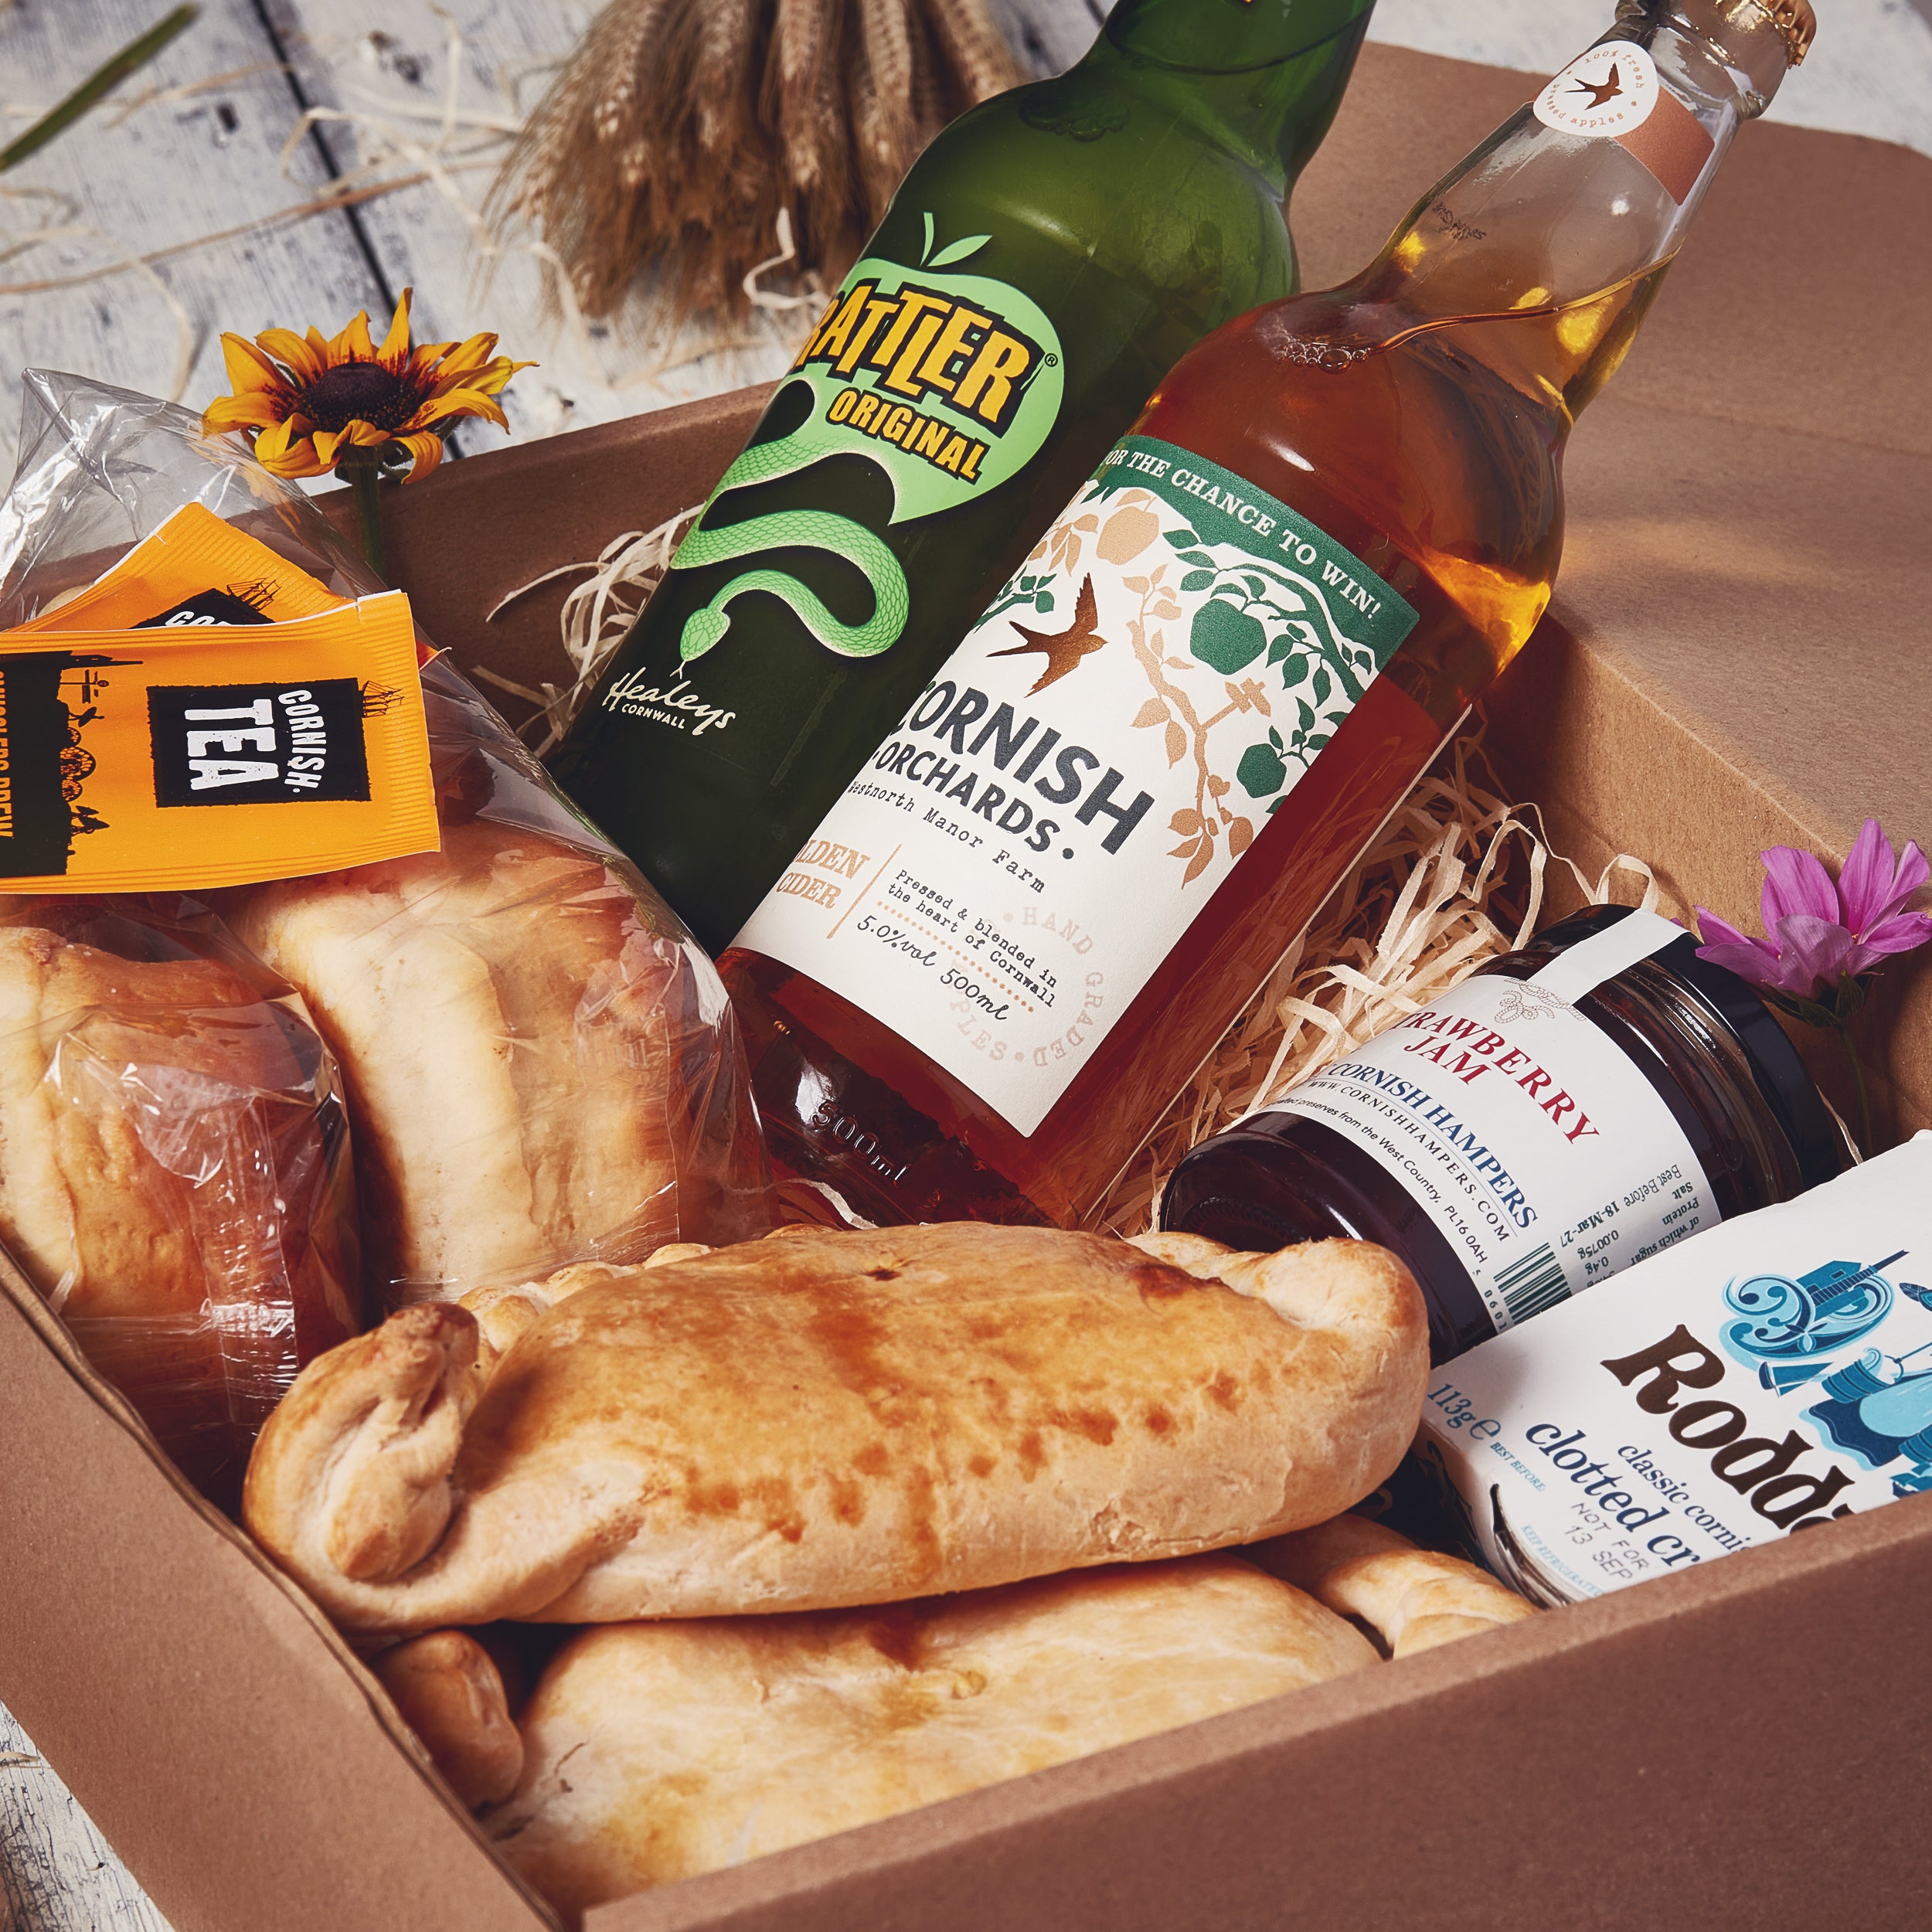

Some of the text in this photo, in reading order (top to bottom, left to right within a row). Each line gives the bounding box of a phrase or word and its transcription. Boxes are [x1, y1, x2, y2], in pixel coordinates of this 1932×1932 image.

[1584, 50, 1645, 89] 100% fresh
[1570, 113, 1624, 128] apples
[827, 389, 988, 483] ORIGINAL
[1127, 451, 1171, 478] THE
[1171, 469, 1277, 537] CHANCE
[1278, 529, 1316, 566] TO
[1321, 560, 1382, 619] WIN!
[185, 699, 278, 791] TEA
[621, 704, 685, 729] CORNWALL
[923, 808, 983, 848] Manor
[992, 849, 1045, 893] Farm
[776, 872, 841, 909] CIDER
[896, 870, 953, 910] Pressed
[957, 909, 968, 920] &
[975, 917, 1035, 969] blended
[1039, 969, 1057, 988] in
[889, 883, 910, 903] the
[917, 900, 958, 933] heart
[965, 934, 985, 950] of
[990, 951, 1056, 1008] Cornwall
[940, 968, 1009, 1020] 500ml
[1022, 906, 1104, 1067] HAND GRADED
[1403, 1036, 1492, 1086] JAM
[1298, 1098, 1341, 1116] preserves
[1338, 1111, 1362, 1128] from
[1361, 1126, 1378, 1140] the
[1379, 1137, 1404, 1162] West
[1403, 1159, 1440, 1202] Country,
[1328, 1063, 1538, 1229] CORNISH HAMPERS
[1560, 1165, 1682, 1247] Best Before 18-Mar-27
[1672, 1182, 1693, 1199] Salt
[1689, 1216, 1699, 1230] of
[1585, 1197, 1699, 1275] Protein 0.4g
[1658, 1225, 1689, 1247] which
[1490, 1442, 1515, 1461] BEST
[1526, 1423, 1670, 1532] clotted
[1571, 1502, 1649, 1570] NOT FOR
[1617, 1446, 1751, 1552] classic corni
[1565, 1526, 1633, 1579] 13 SEP
